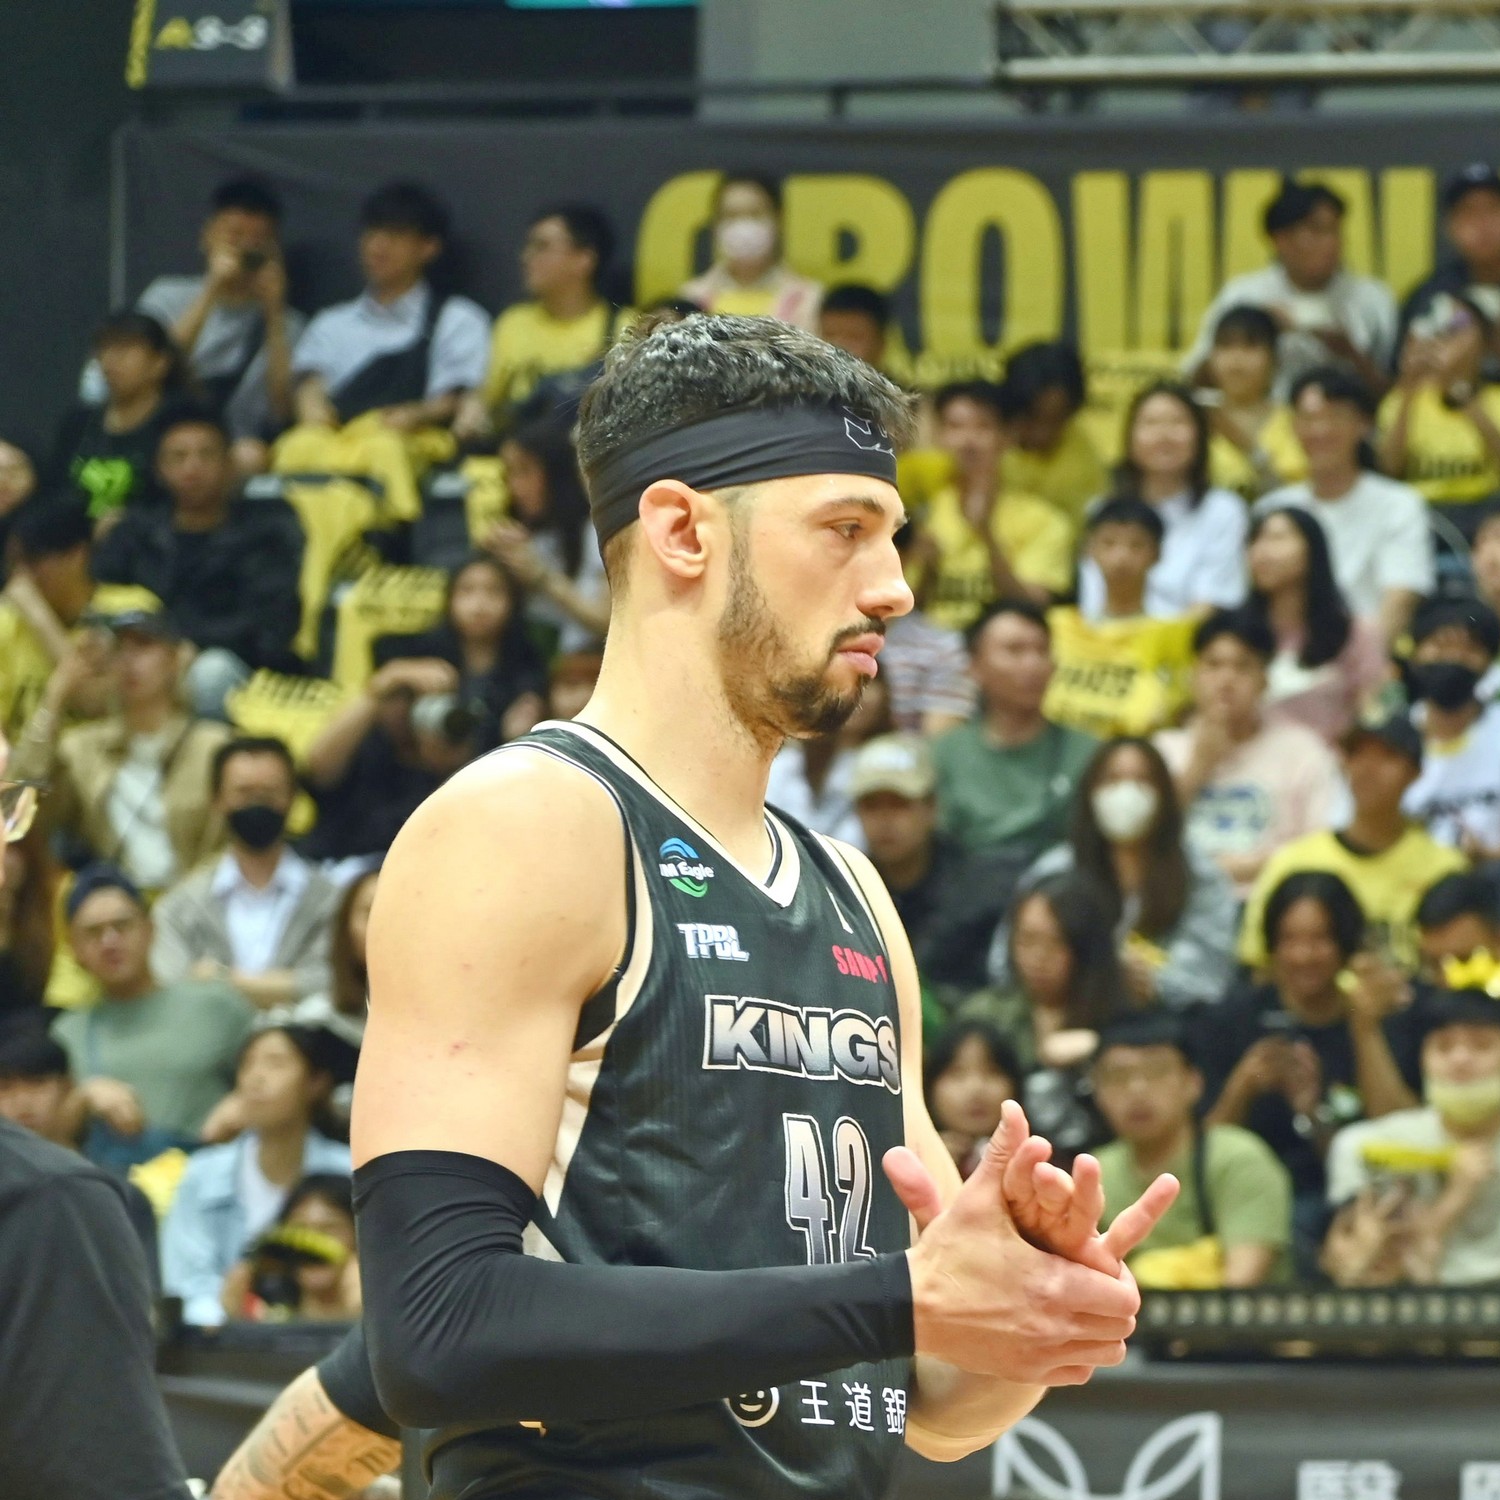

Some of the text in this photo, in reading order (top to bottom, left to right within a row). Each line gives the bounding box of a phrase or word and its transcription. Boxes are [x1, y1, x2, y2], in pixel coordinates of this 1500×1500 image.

[677, 860, 716, 881] Eagle
[702, 994, 902, 1095] KINGS
[782, 1112, 877, 1267] 42
